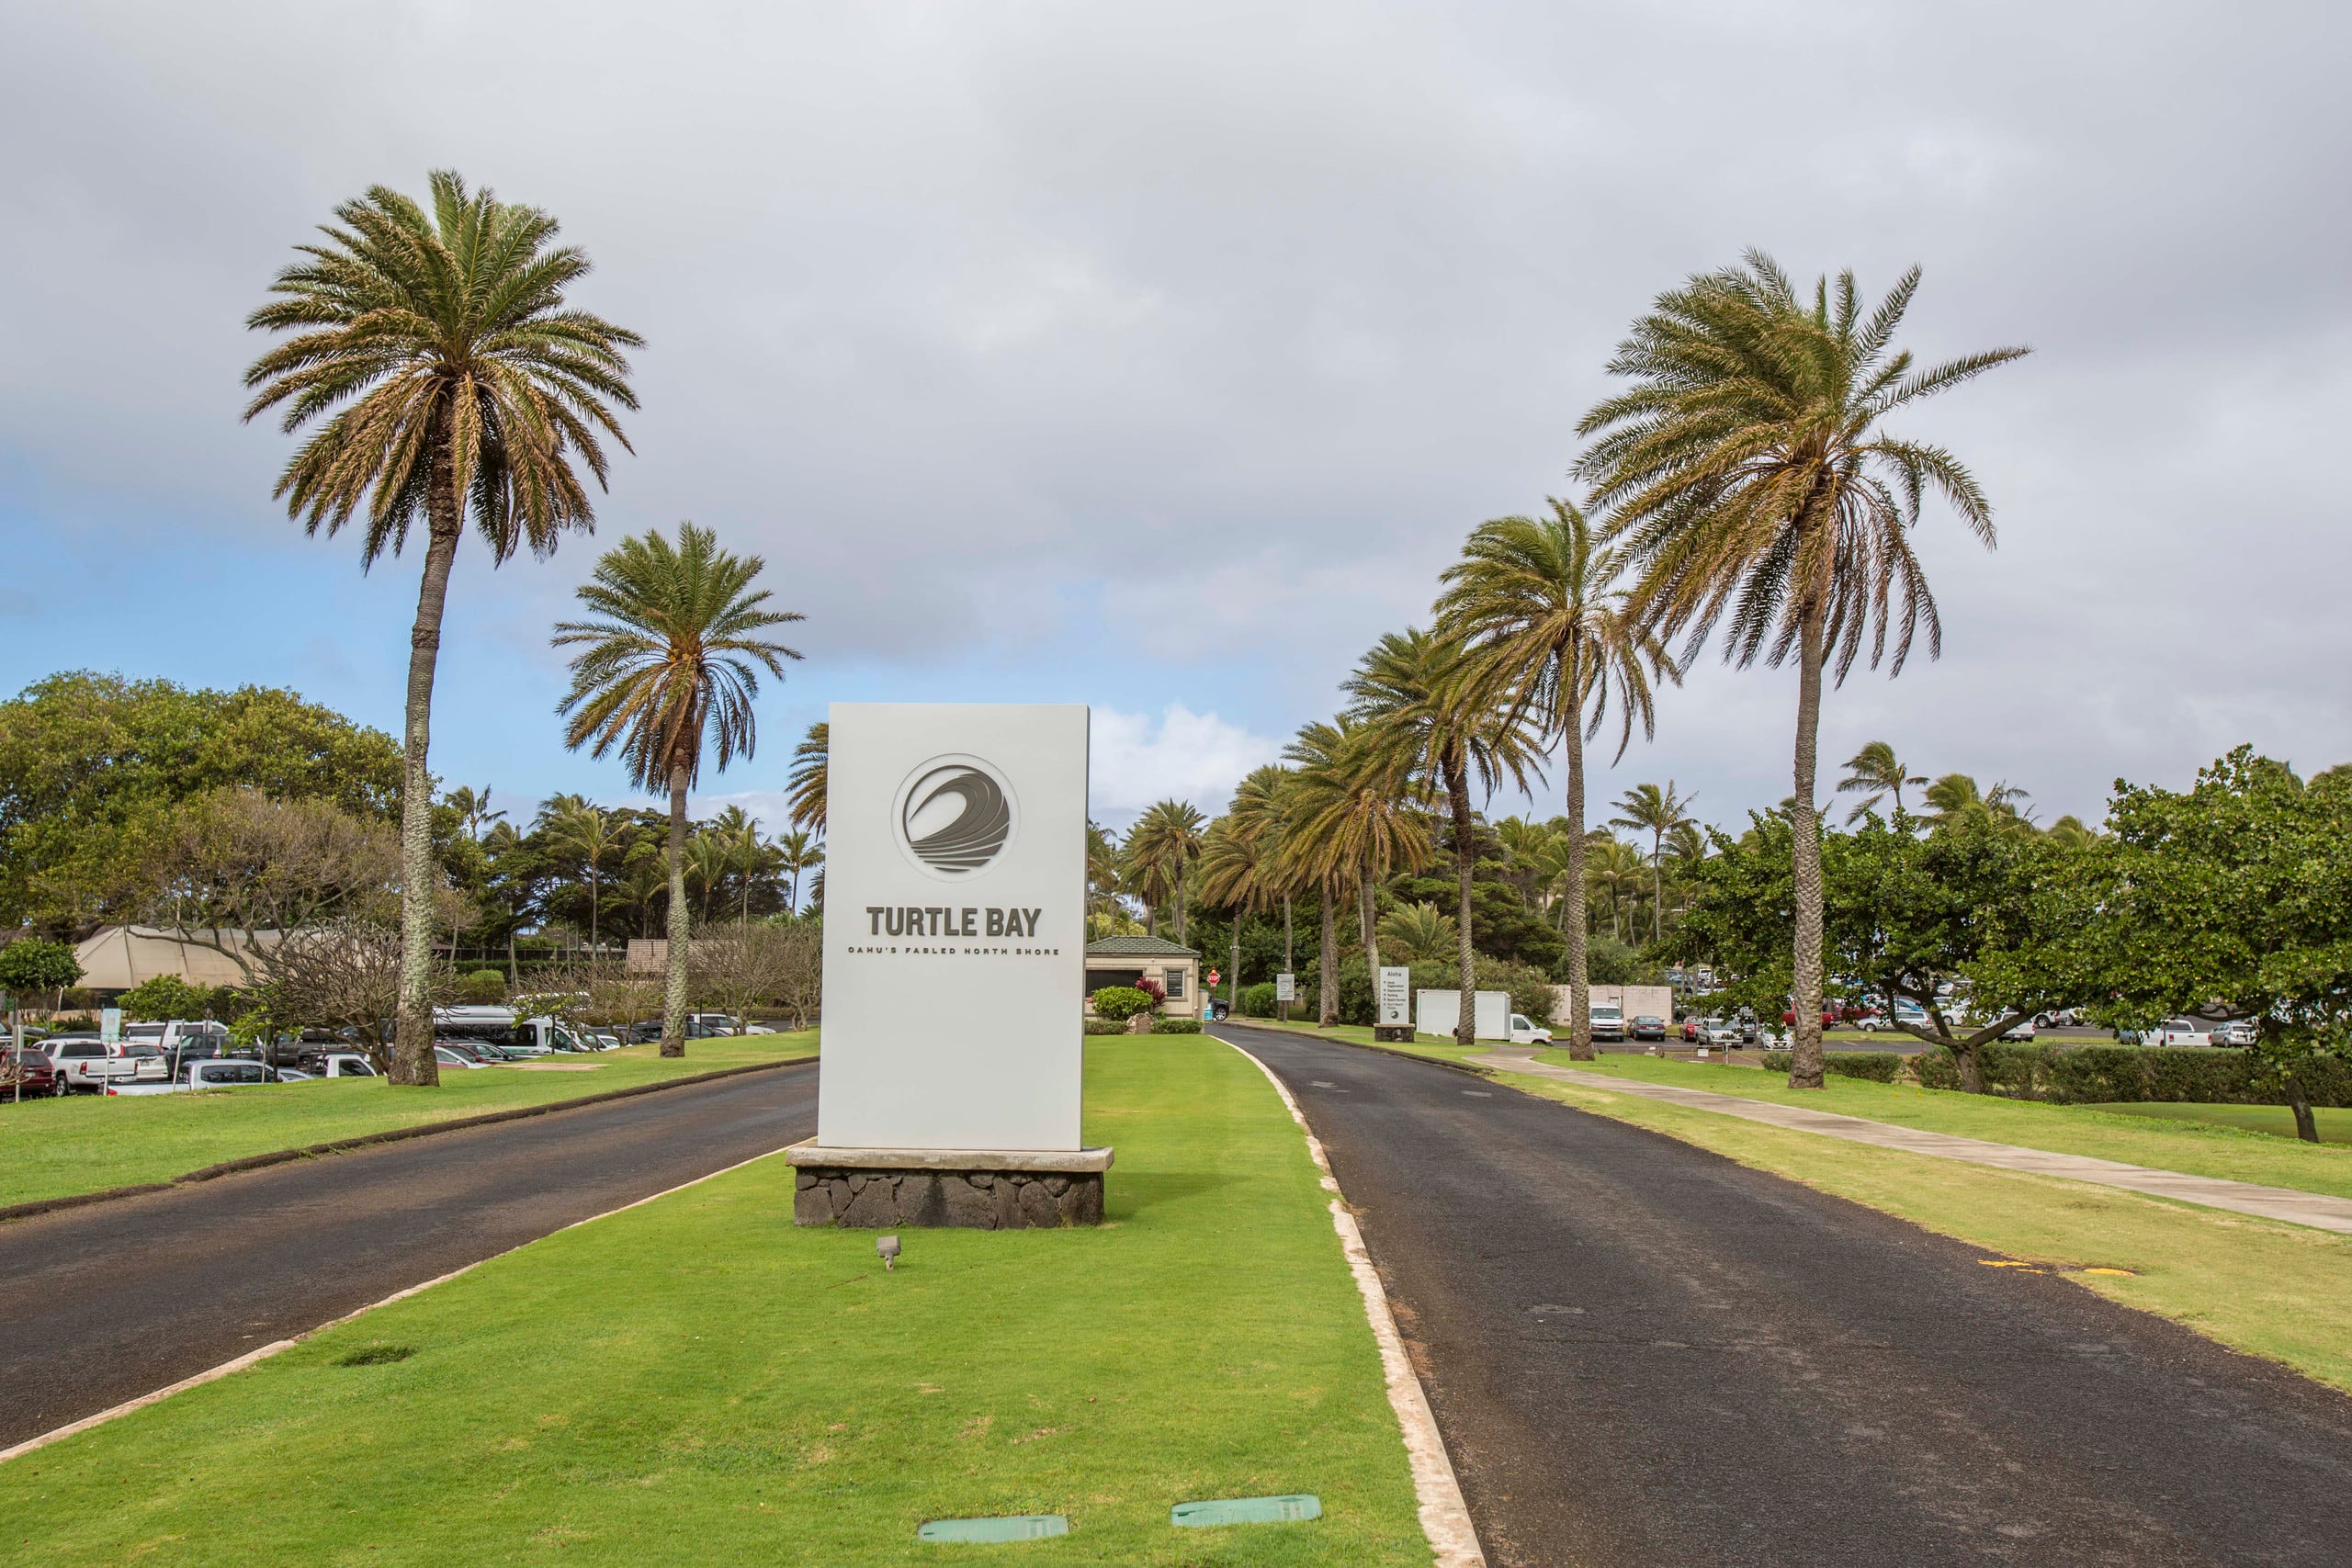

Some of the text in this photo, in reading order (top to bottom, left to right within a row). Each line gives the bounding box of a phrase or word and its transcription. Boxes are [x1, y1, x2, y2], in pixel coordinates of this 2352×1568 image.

[866, 907, 1042, 937] TURTLE BAY
[848, 946, 897, 954] OAHU'S
